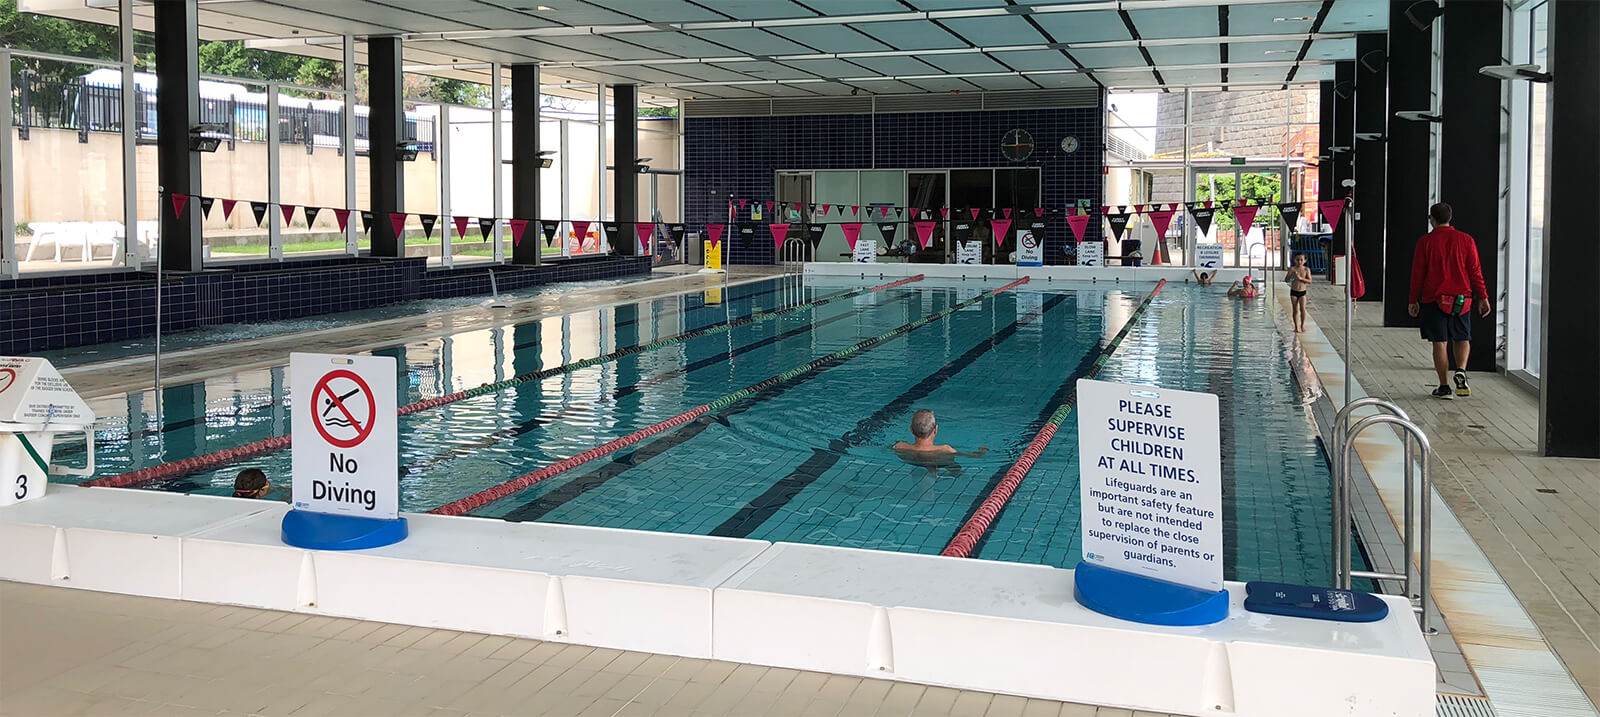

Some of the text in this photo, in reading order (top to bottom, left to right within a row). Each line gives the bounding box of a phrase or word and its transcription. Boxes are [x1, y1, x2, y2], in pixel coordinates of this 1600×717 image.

[1120, 400, 1172, 418] PLEASE
[1108, 418, 1185, 440] SUPERVISE
[1111, 438, 1183, 460] CHILDREN
[330, 452, 358, 474] No
[1098, 456, 1200, 484] AT ALL TIMES.
[15, 474, 28, 500] 3
[313, 480, 376, 510] Diving
[1105, 477, 1192, 500] Lifeguards are an
[1090, 488, 1215, 519] important safety feature
[1098, 502, 1203, 530] but are not intended
[1102, 517, 1199, 544] to replace the close
[1088, 529, 1215, 561] supervision of parents or
[1123, 550, 1176, 568] guardians.
